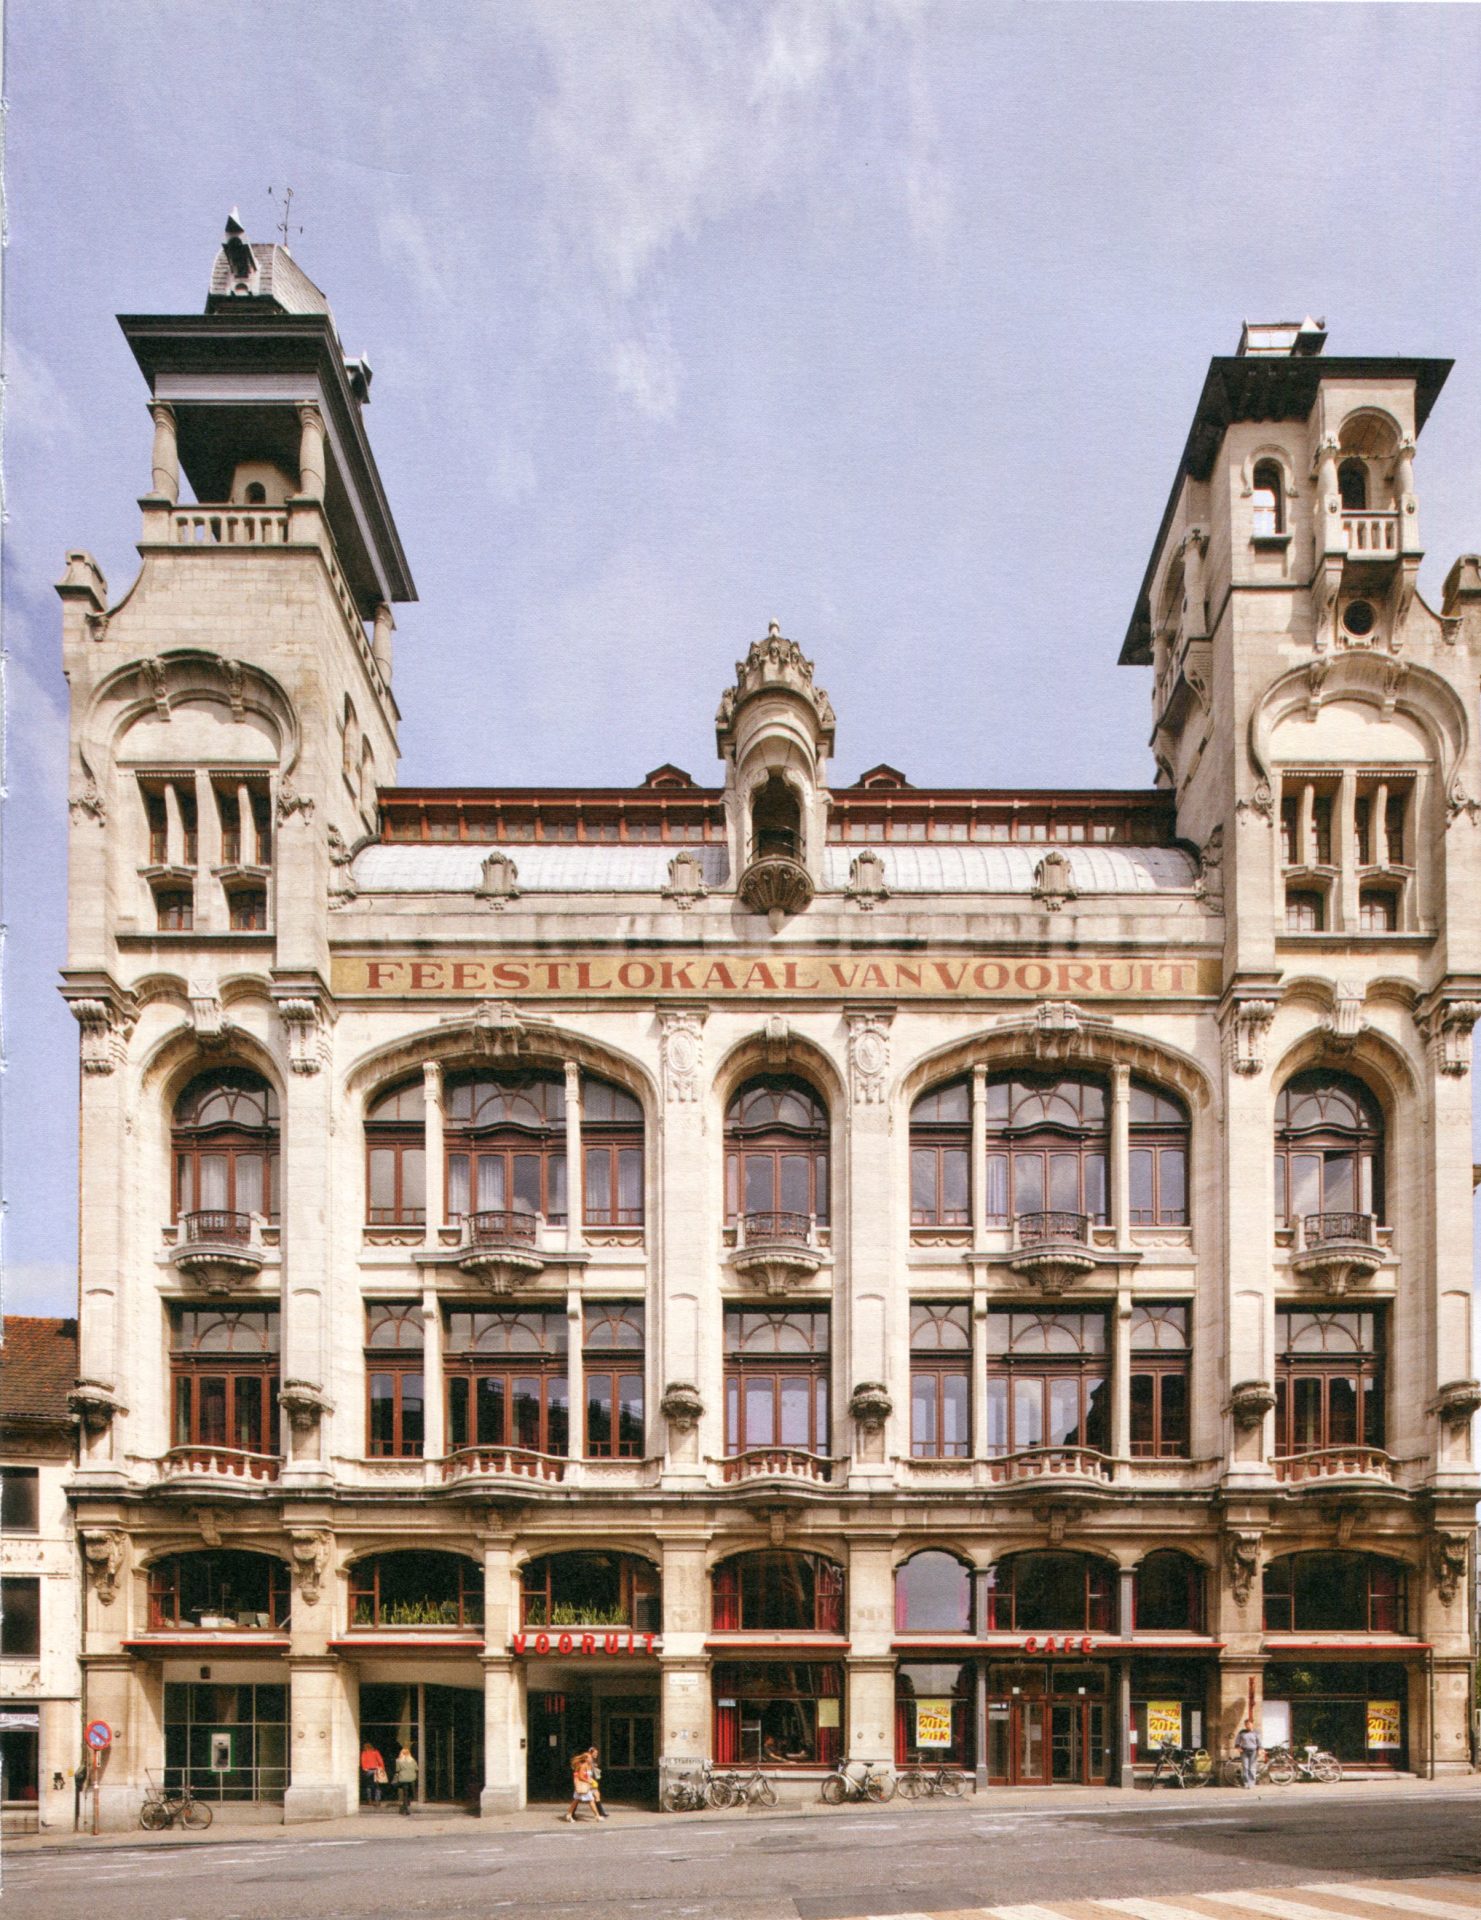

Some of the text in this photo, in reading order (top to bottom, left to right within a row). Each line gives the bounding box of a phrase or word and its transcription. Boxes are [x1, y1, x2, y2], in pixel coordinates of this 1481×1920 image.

[366, 961, 1196, 992] FEESTLOKAAL VAN VOORUIT
[512, 1632, 656, 1655] VOORUIT
[1025, 1635, 1093, 1655] CAFE
